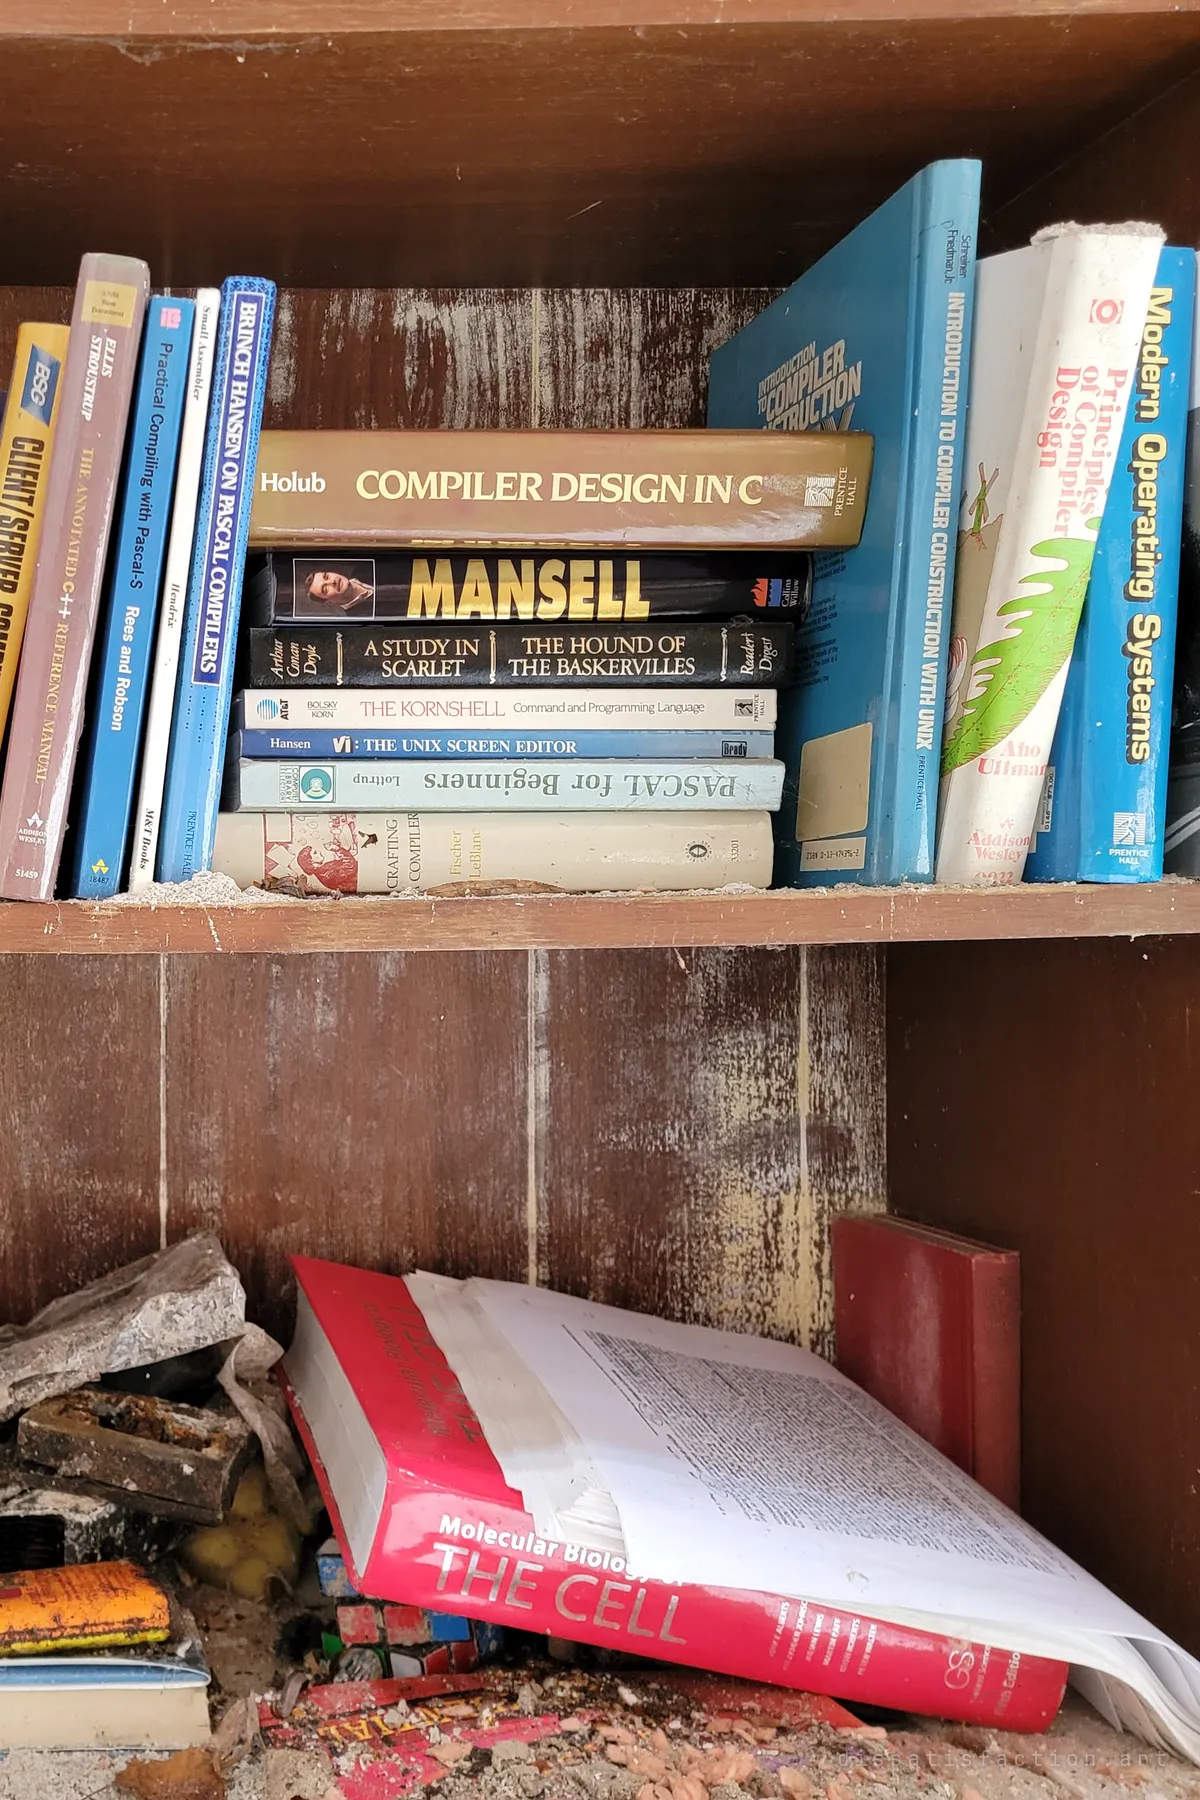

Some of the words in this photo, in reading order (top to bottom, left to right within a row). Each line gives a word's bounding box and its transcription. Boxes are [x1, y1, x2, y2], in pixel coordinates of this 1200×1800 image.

[233, 302, 258, 375] BRINCH
[941, 292, 965, 416] INTRODUCTION
[1137, 287, 1173, 422] Modern
[82, 335, 103, 422] STROUSTRUP
[152, 343, 174, 408] Practical
[227, 380, 250, 457] HANSEN
[939, 420, 956, 441] TO
[139, 414, 164, 487] Compiling
[220, 460, 238, 491] ON
[260, 472, 326, 493] Holub
[356, 470, 543, 501] COMPILER
[550, 473, 687, 503] DESIGN
[693, 475, 733, 504] IN
[738, 475, 763, 505] C
[932, 444, 955, 529] COMPILER
[138, 491, 152, 522] with
[1124, 433, 1167, 602] Operating
[211, 494, 236, 568] PASCAL
[130, 526, 150, 589] Pascal-S
[406, 558, 651, 621] MANSELL
[922, 532, 948, 659] CONSTRUCTION
[200, 572, 227, 674] COMPILERS
[521, 637, 565, 655] THE
[570, 637, 653, 655] HOUND
[659, 636, 686, 654] OF
[364, 642, 379, 656] A
[382, 639, 450, 656] STUDY
[461, 639, 480, 656] IN
[382, 659, 465, 677] SCARLET
[509, 659, 550, 676] THE
[554, 657, 695, 676] BASKERVILLES
[918, 661, 937, 703] WITH
[1122, 613, 1161, 764] Systems
[360, 701, 396, 716] THE
[401, 701, 505, 717] KORNSHELL
[513, 703, 565, 713] Command
[567, 703, 586, 713] and
[589, 703, 654, 716] Programming
[658, 703, 705, 715] Language
[916, 705, 934, 750] UNIX
[364, 739, 397, 752] THE
[402, 739, 442, 752] UNIX
[447, 739, 510, 752] SCREEN
[516, 741, 577, 753] EDITOR
[353, 772, 400, 786] Lottrup
[424, 767, 560, 796] Beginners
[571, 774, 612, 797] for
[624, 774, 738, 797] PASCAL
[15, 869, 39, 879] 51459
[450, 830, 461, 876] Fischer
[470, 828, 481, 878] LeBlanc
[439, 1515, 559, 1558] Molecular
[434, 1542, 544, 1610] THE
[556, 1575, 686, 1645] CELL
